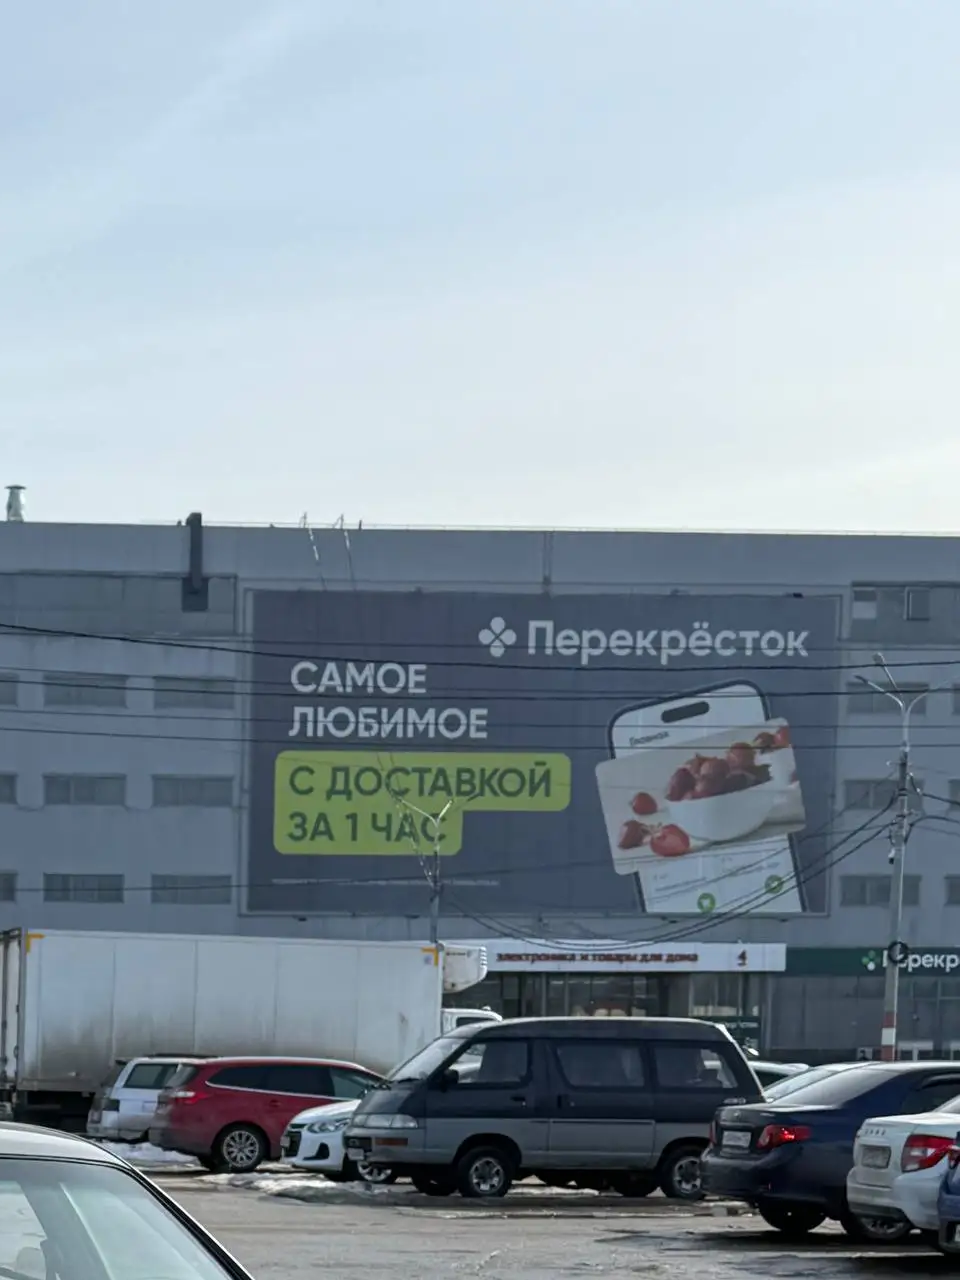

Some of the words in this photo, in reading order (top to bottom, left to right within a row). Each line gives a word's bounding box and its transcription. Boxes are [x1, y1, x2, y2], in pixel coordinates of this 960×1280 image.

[526, 619, 810, 665] Перекрёсток
[290, 661, 428, 694] САМОЕ
[288, 706, 489, 739] ЛЮБИМОЕ
[288, 766, 315, 797] С
[325, 760, 552, 799] ДОСТАВКОЙ
[287, 811, 335, 842] ЗА
[344, 812, 359, 842] 1
[370, 812, 448, 843] ЧАС
